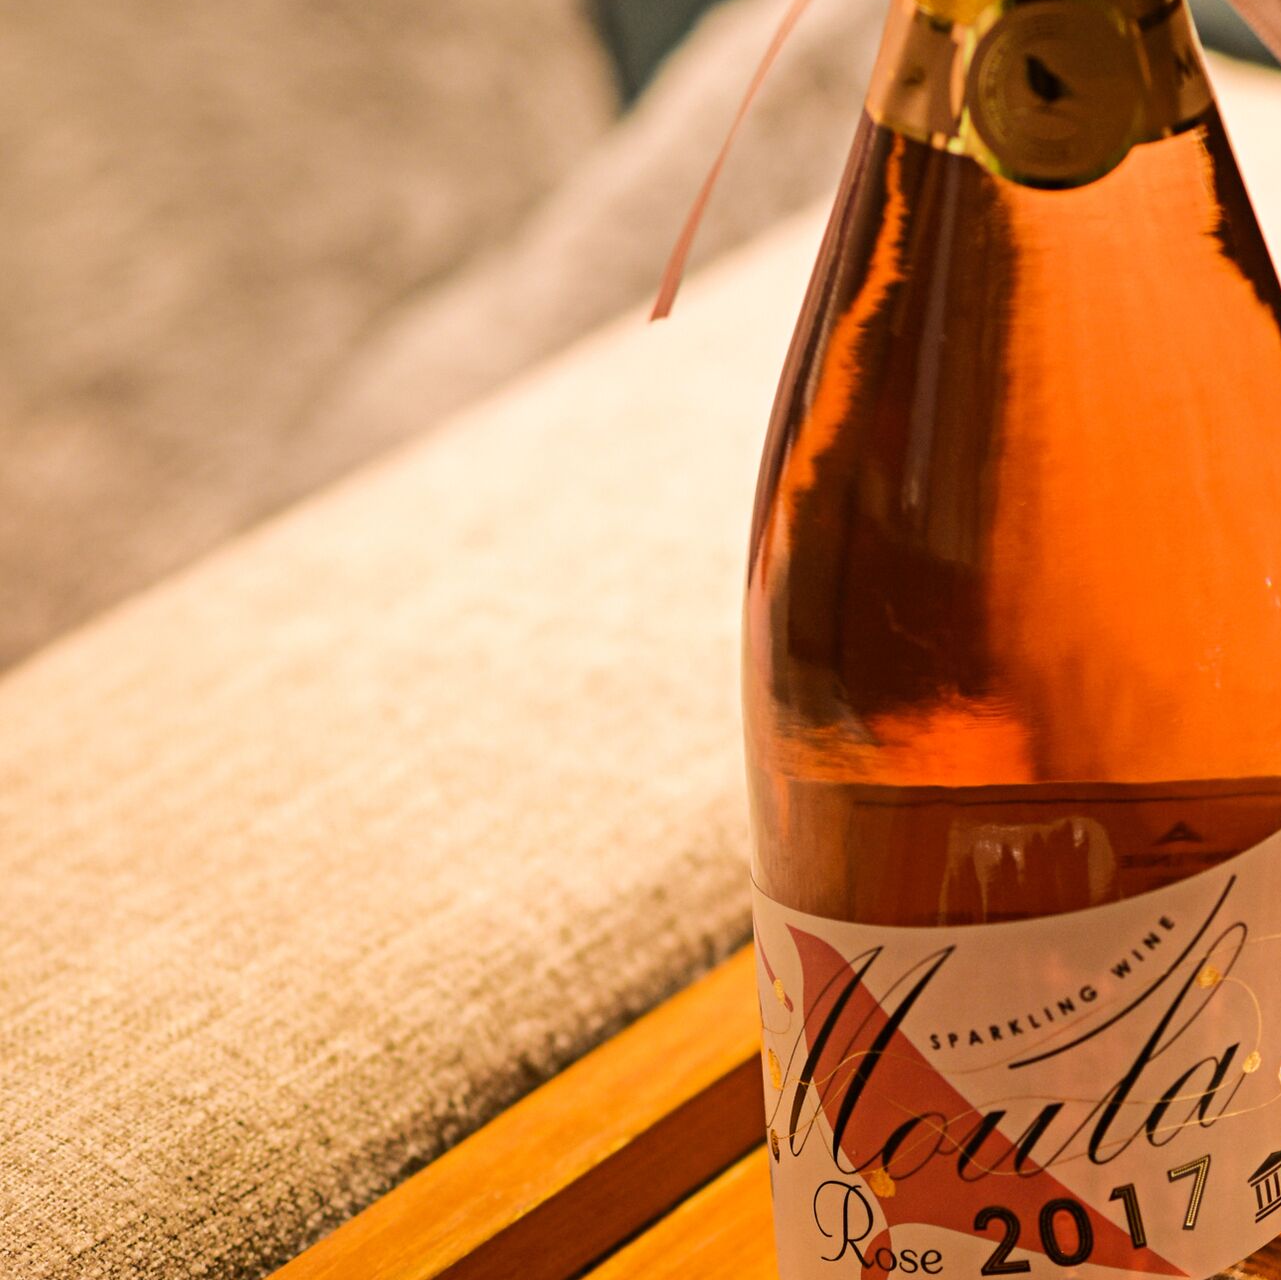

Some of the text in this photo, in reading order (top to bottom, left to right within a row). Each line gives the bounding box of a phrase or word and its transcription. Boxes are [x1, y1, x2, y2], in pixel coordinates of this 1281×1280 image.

[929, 915, 1175, 1051] SPARKLING WINE
[766, 922, 1246, 1182] Moula
[813, 1153, 1212, 1277] Rose 2017
